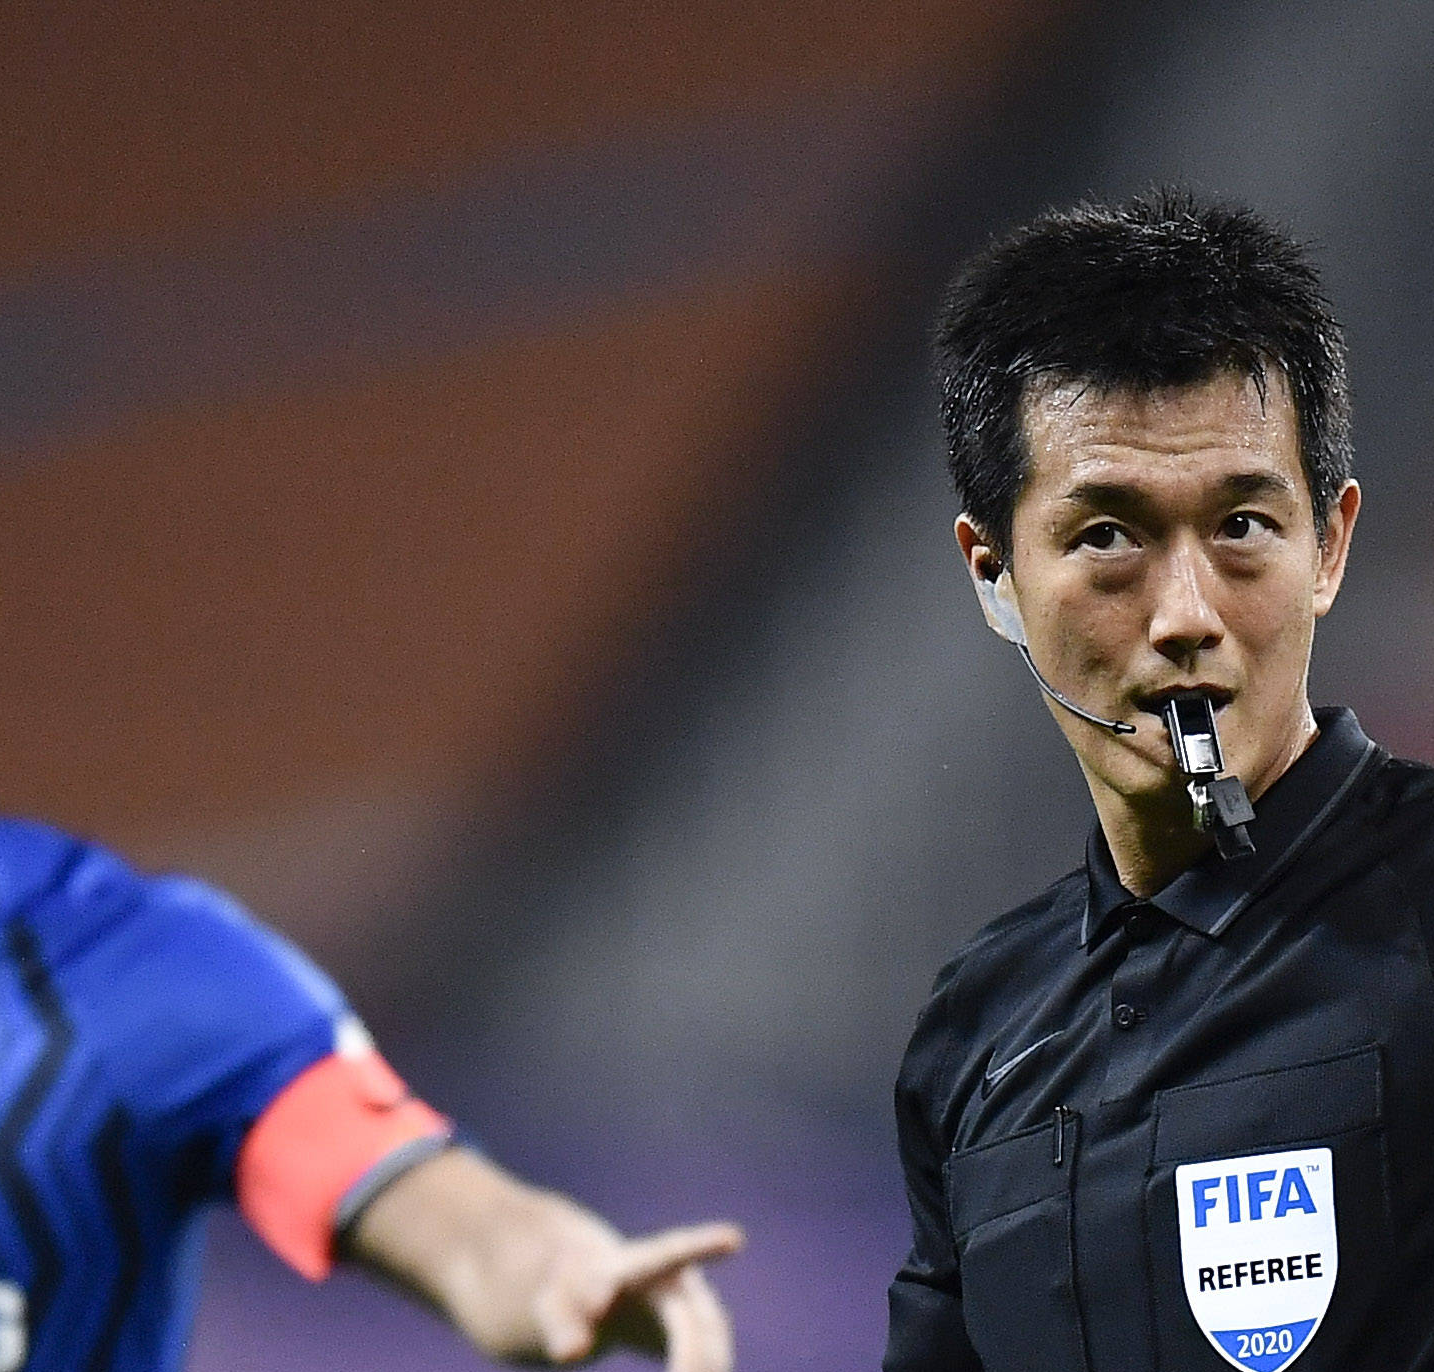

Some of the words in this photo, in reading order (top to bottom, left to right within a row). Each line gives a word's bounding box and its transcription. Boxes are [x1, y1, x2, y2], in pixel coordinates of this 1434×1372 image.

[1191, 1167, 1317, 1228] FIFA
[1198, 1253, 1323, 1292] REFEREE
[1237, 1329, 1293, 1359] 2020
